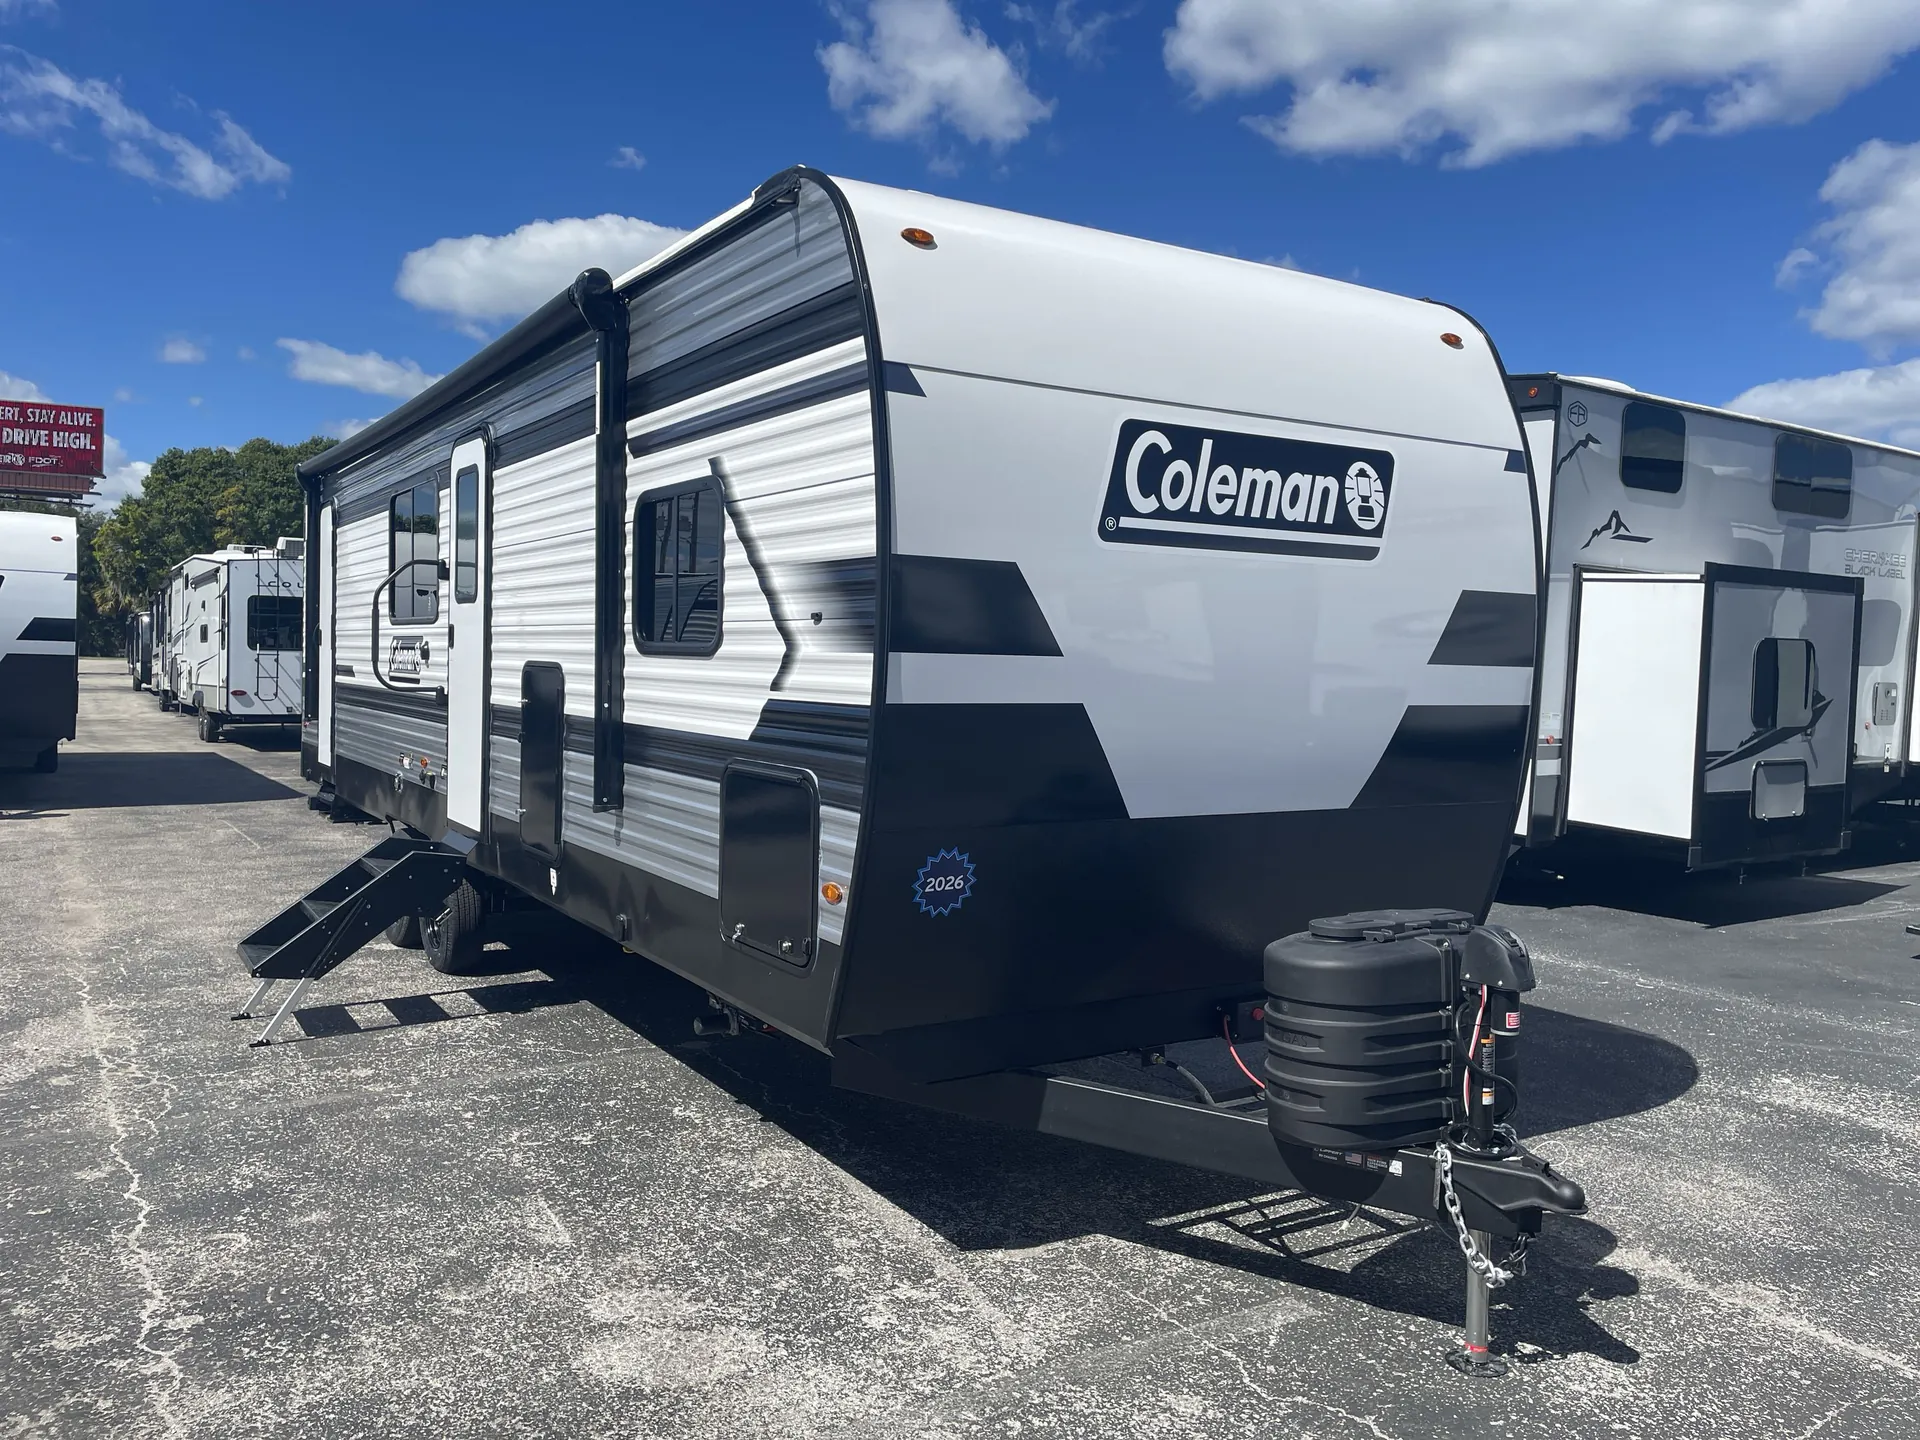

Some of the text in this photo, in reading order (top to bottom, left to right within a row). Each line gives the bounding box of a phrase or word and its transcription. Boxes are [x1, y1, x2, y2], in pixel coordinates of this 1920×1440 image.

[27, 408, 57, 424] STAY
[58, 411, 96, 427] ALIVE.
[2, 427, 96, 450] DRIVE HIGH.
[1125, 429, 1339, 525] Coleman
[1844, 564, 1906, 580] BLACK LABEL
[924, 875, 964, 893] 2026
